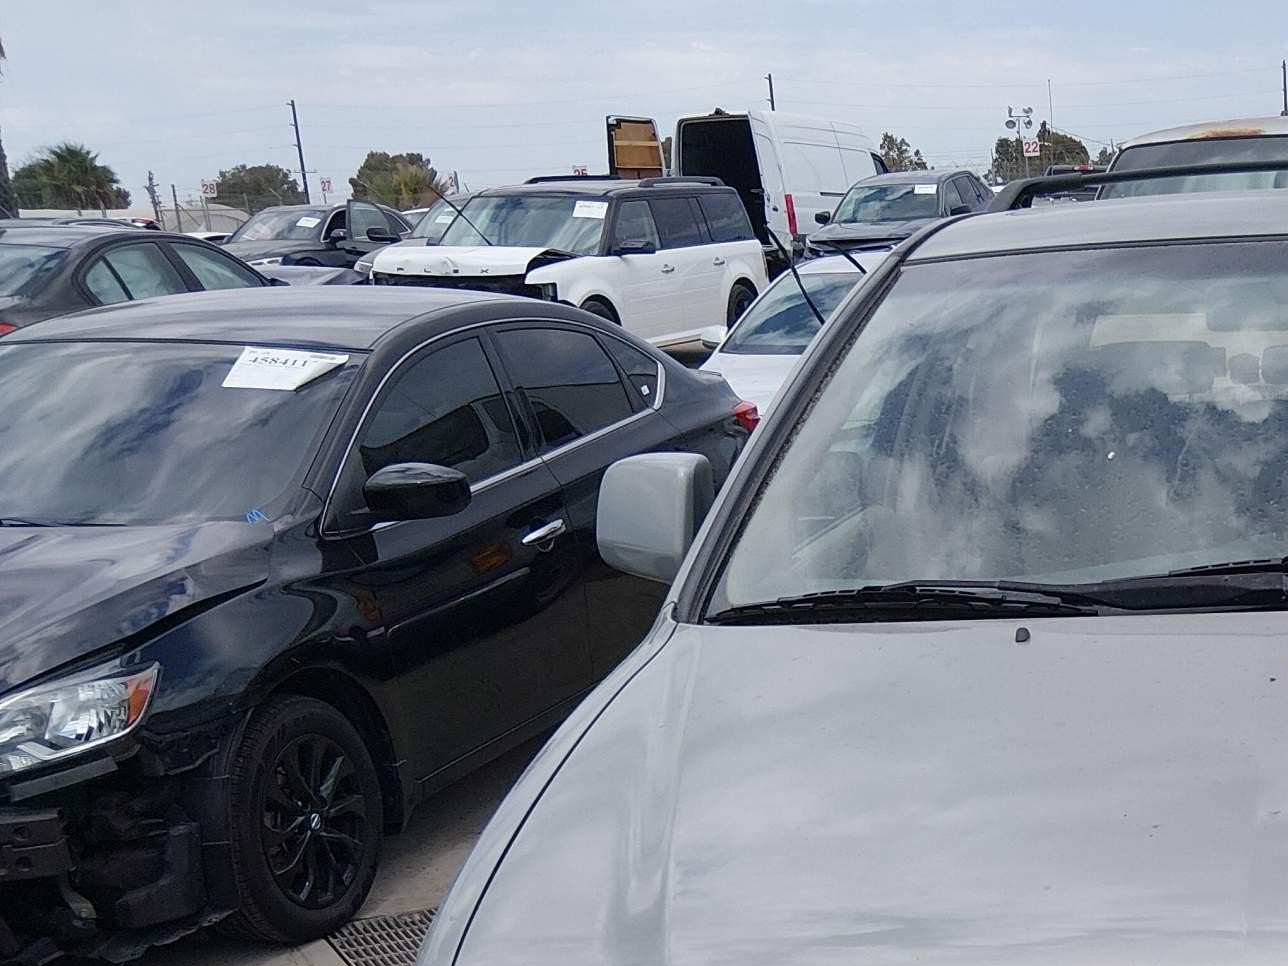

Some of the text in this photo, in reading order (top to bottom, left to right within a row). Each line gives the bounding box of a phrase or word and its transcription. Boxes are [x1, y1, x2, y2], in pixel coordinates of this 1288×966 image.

[1023, 141, 1039, 154] 22
[202, 183, 216, 194] 28
[320, 180, 331, 192] 27
[248, 356, 319, 367] 458411
